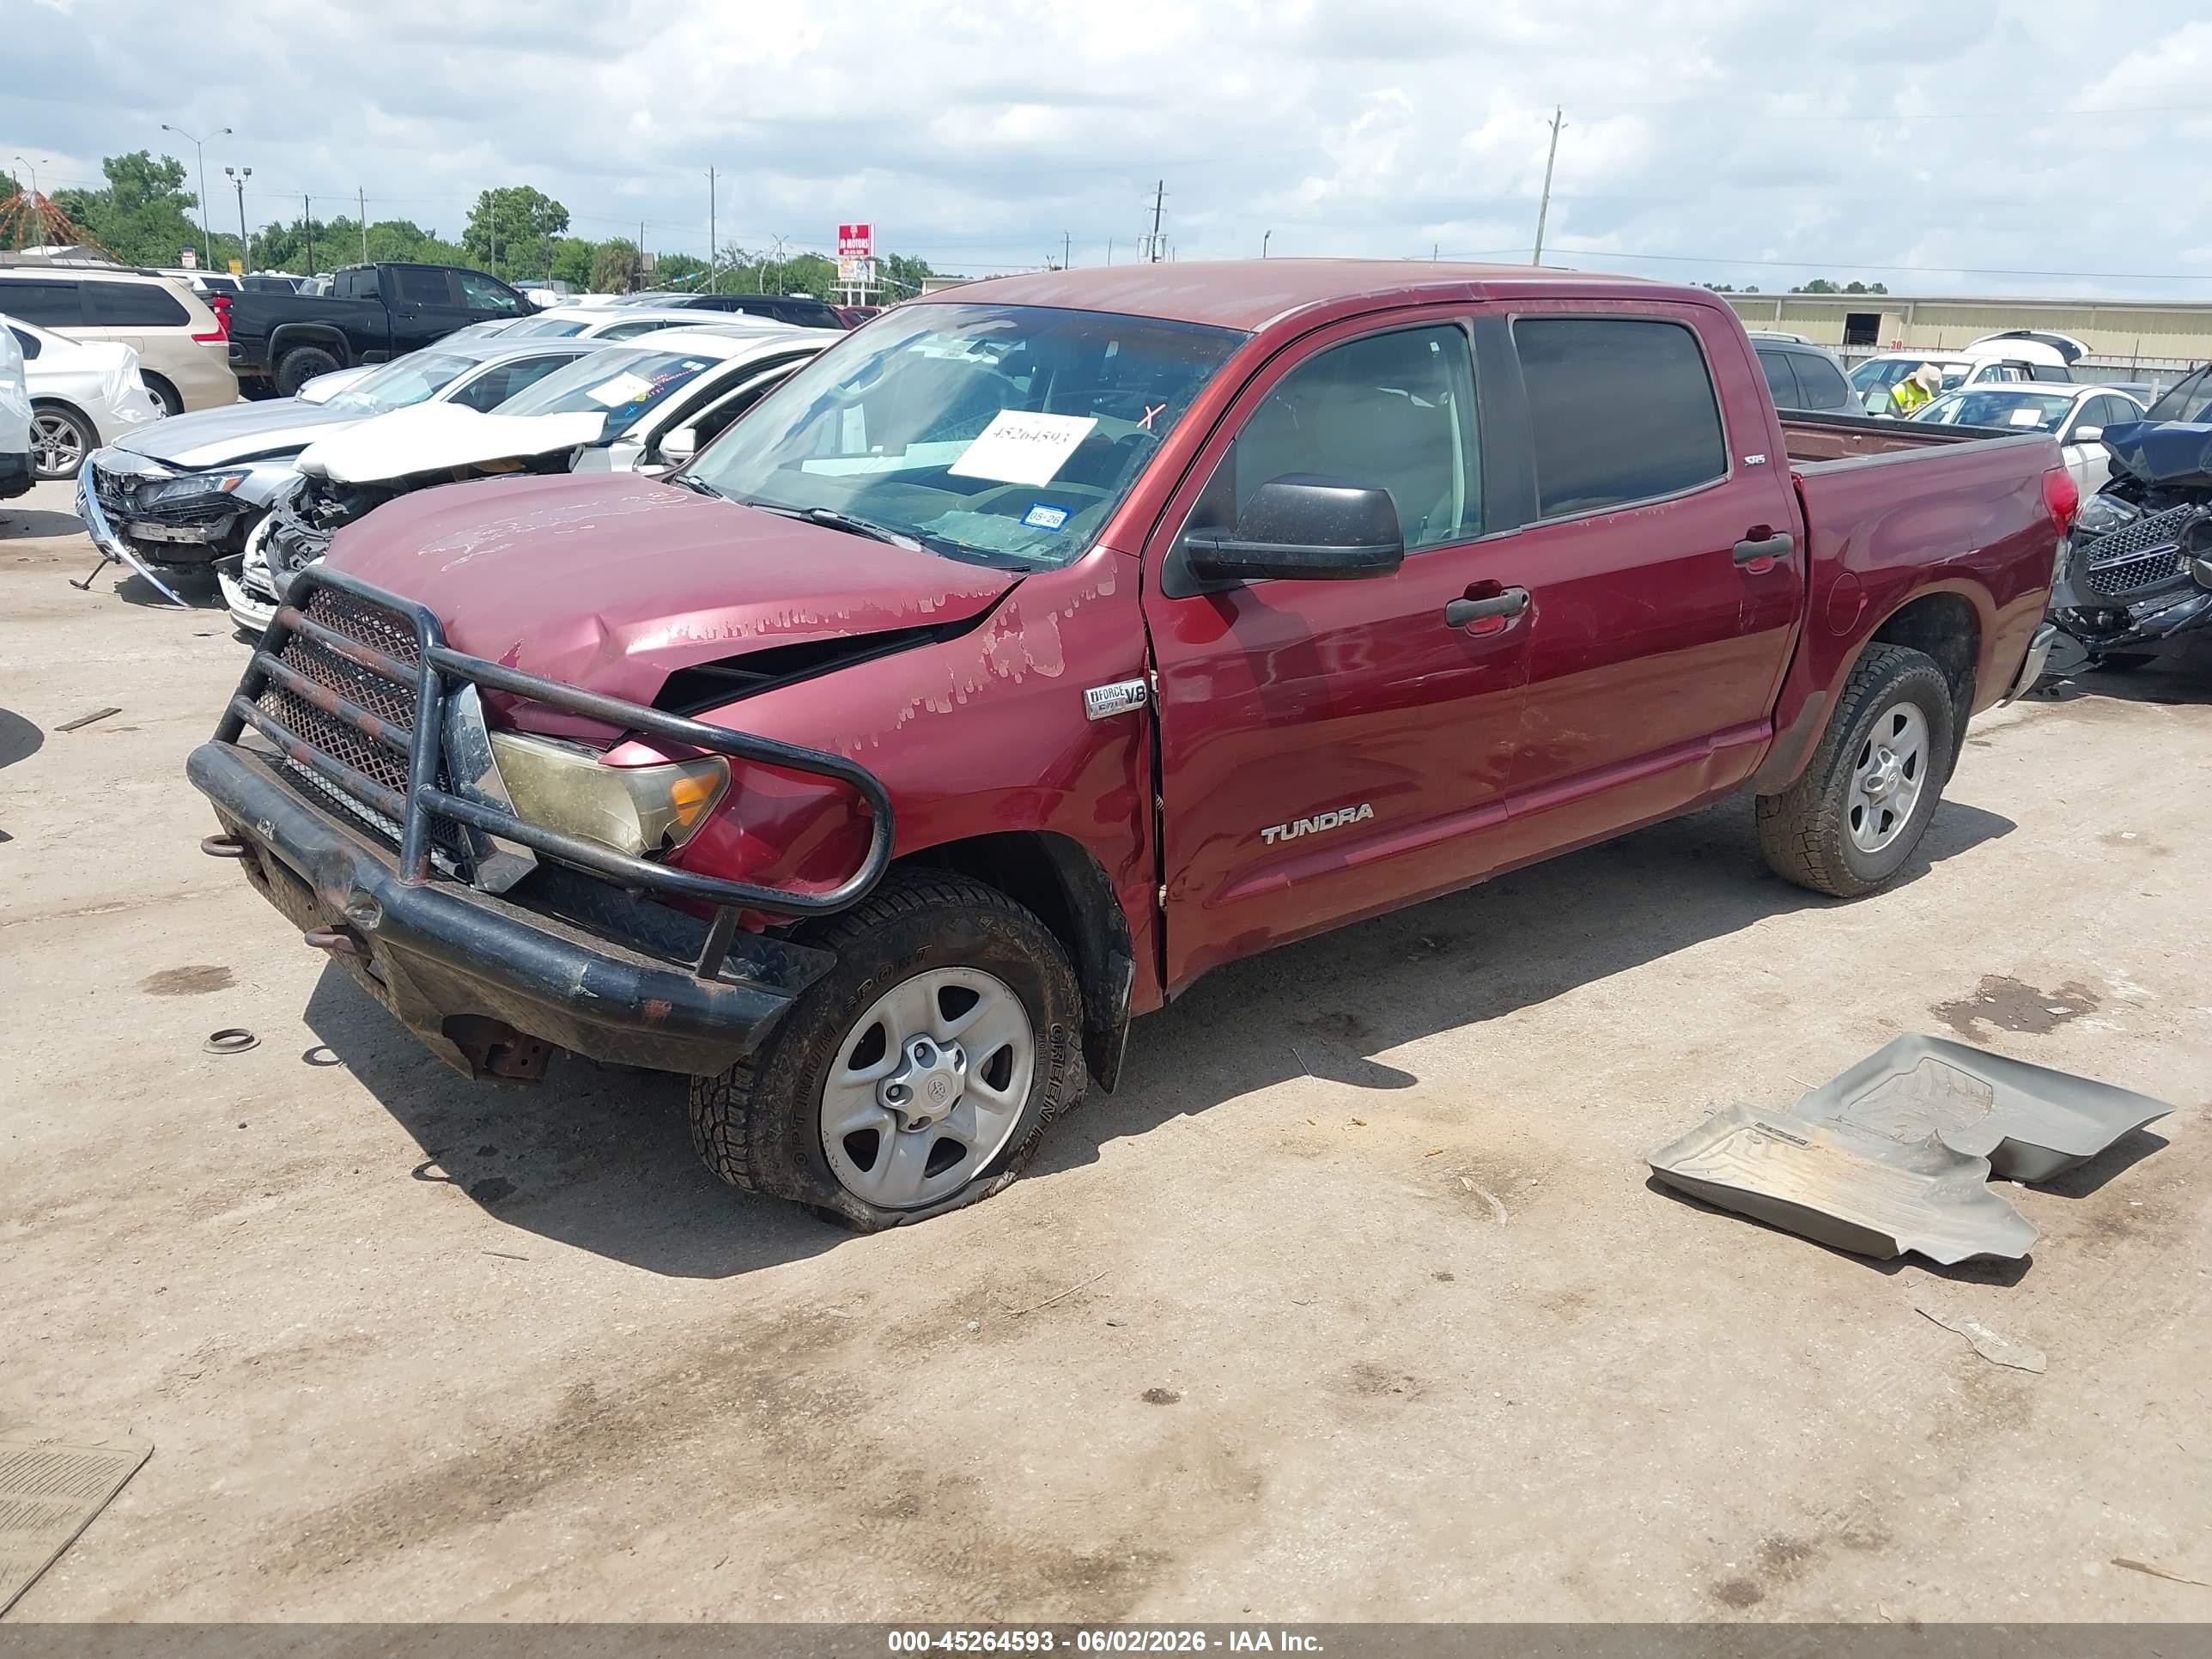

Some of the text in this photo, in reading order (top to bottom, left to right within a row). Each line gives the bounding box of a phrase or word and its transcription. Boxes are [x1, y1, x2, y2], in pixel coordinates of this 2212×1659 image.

[847, 238, 868, 249] MOTORS
[1891, 340, 1902, 350] 30
[993, 427, 1072, 445] 45264593
[1125, 684, 1146, 704] V8
[1261, 803, 1375, 845] TUNDRA
